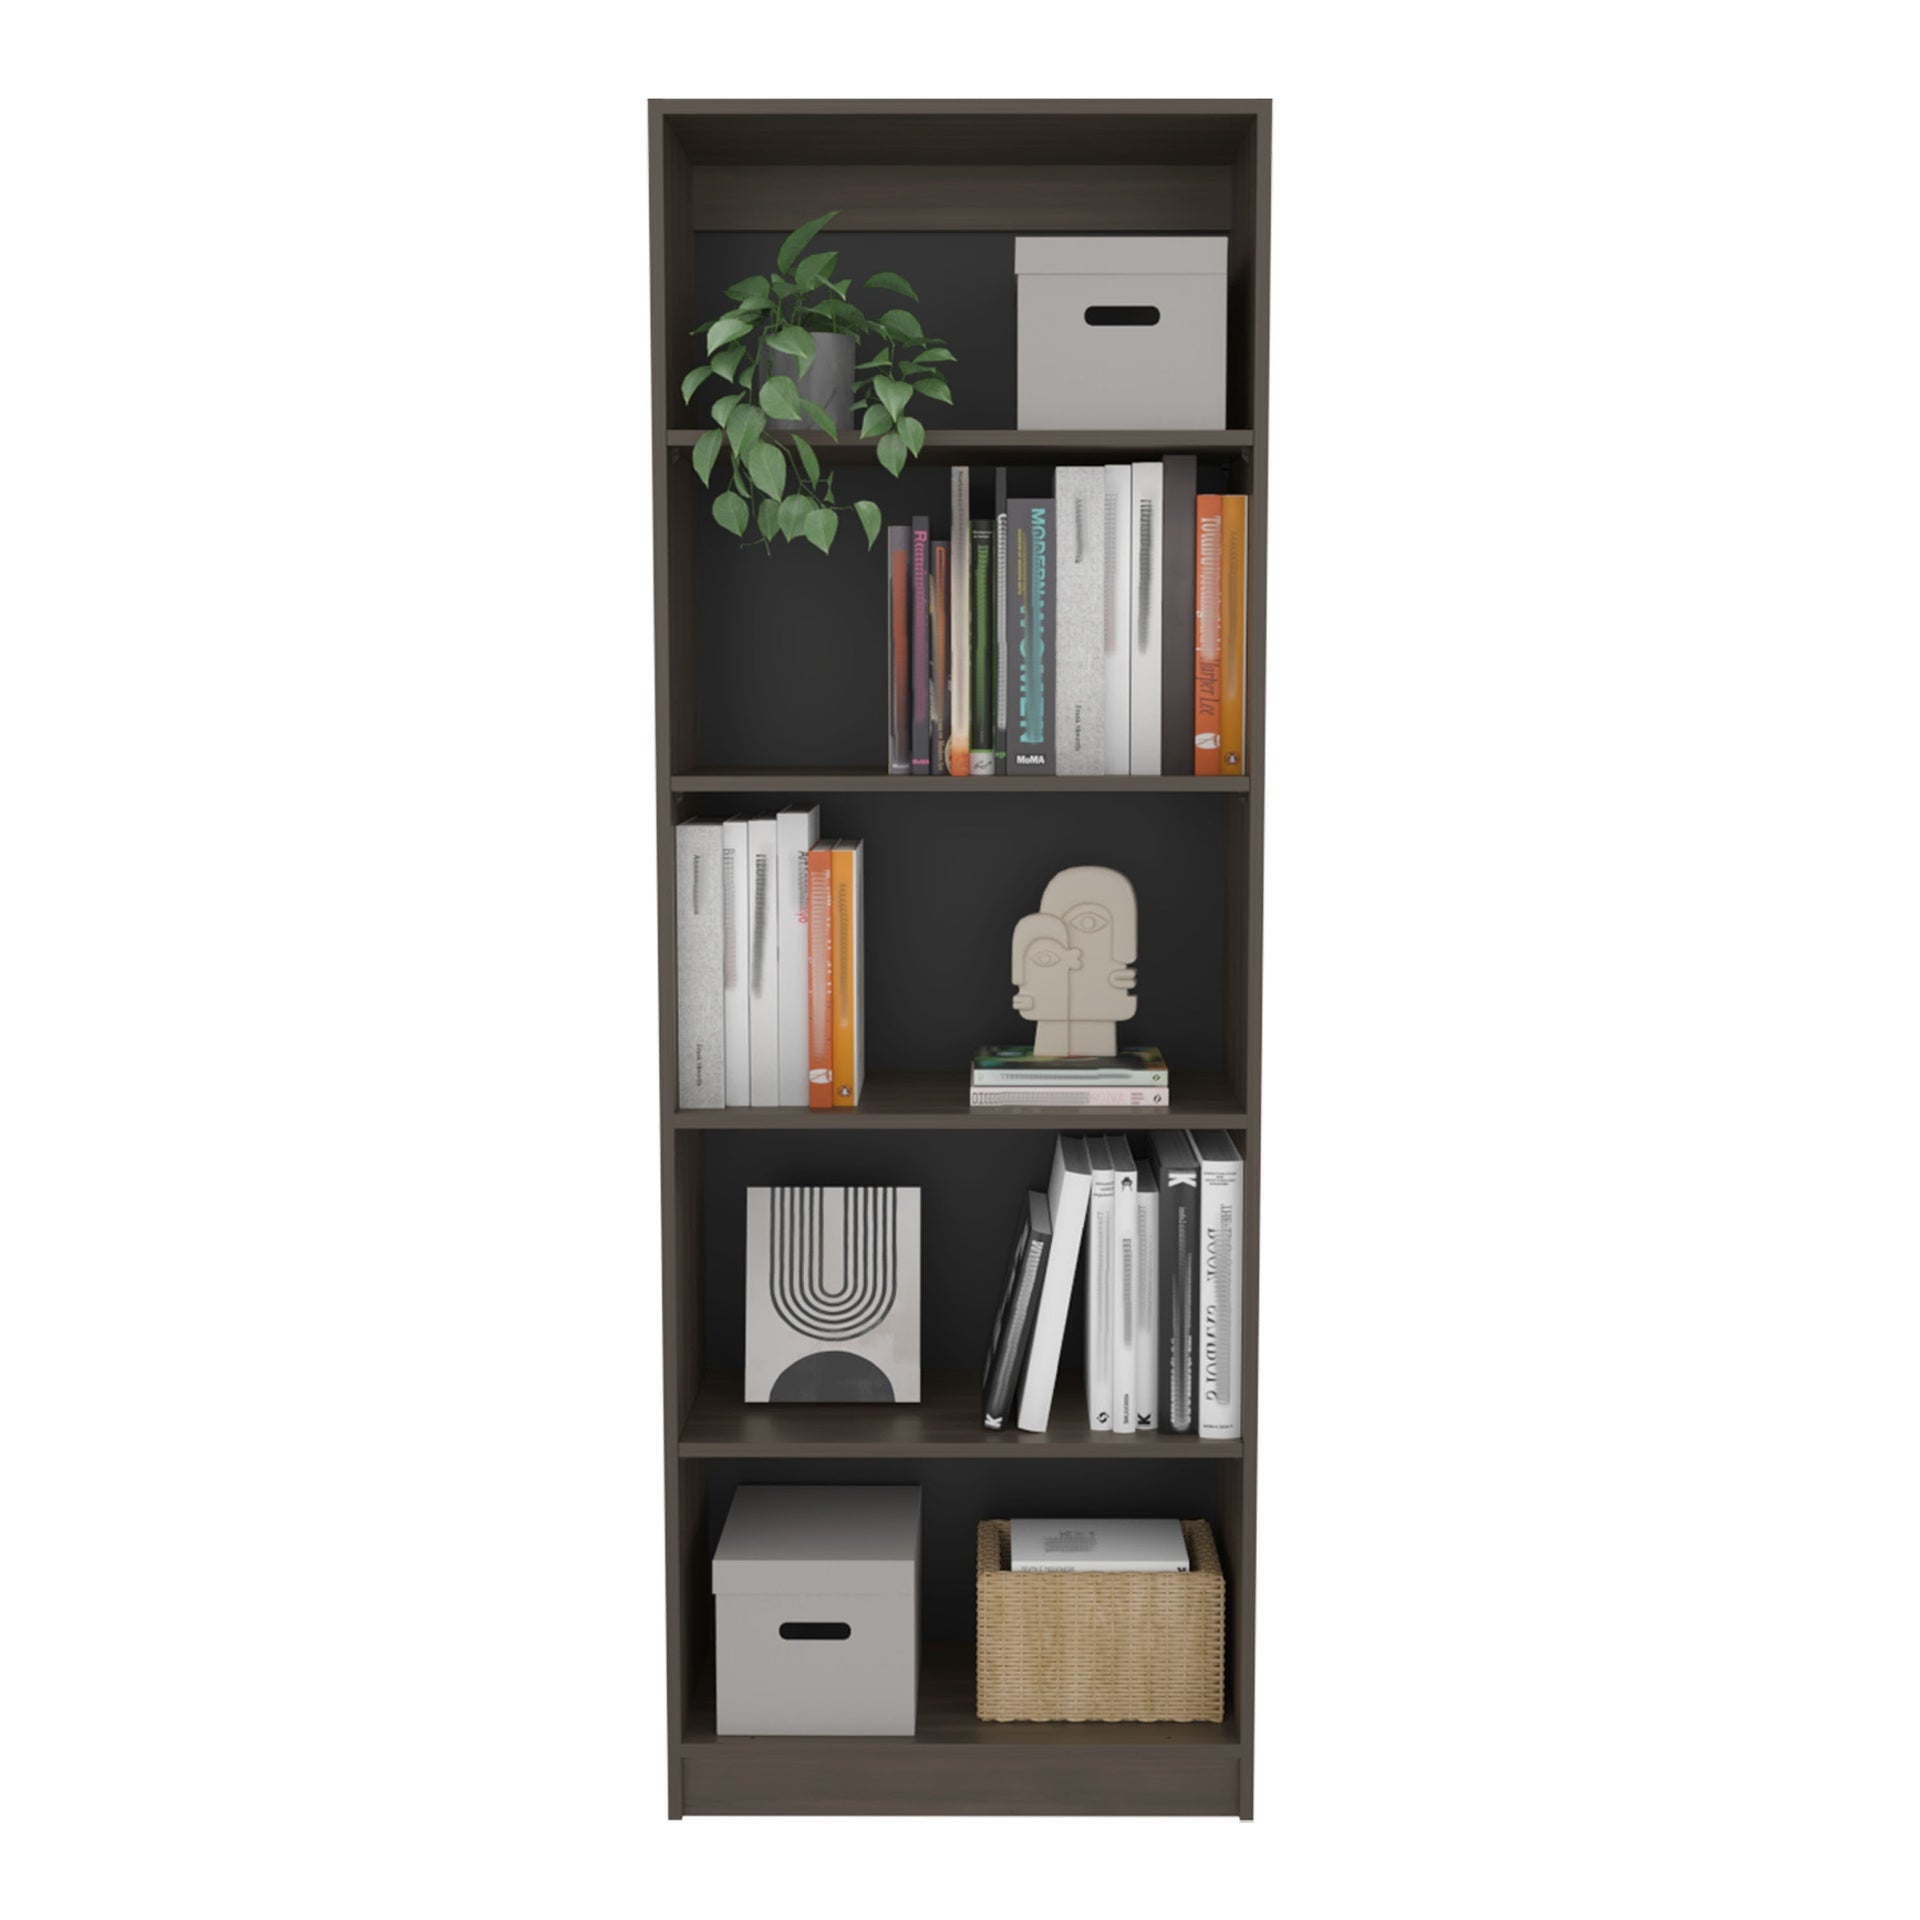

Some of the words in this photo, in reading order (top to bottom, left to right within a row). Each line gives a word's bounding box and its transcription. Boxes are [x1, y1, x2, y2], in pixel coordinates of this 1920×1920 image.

[1016, 754, 1046, 765] MoMA
[1168, 1170, 1197, 1187] K
[1137, 1413, 1152, 1426] K
